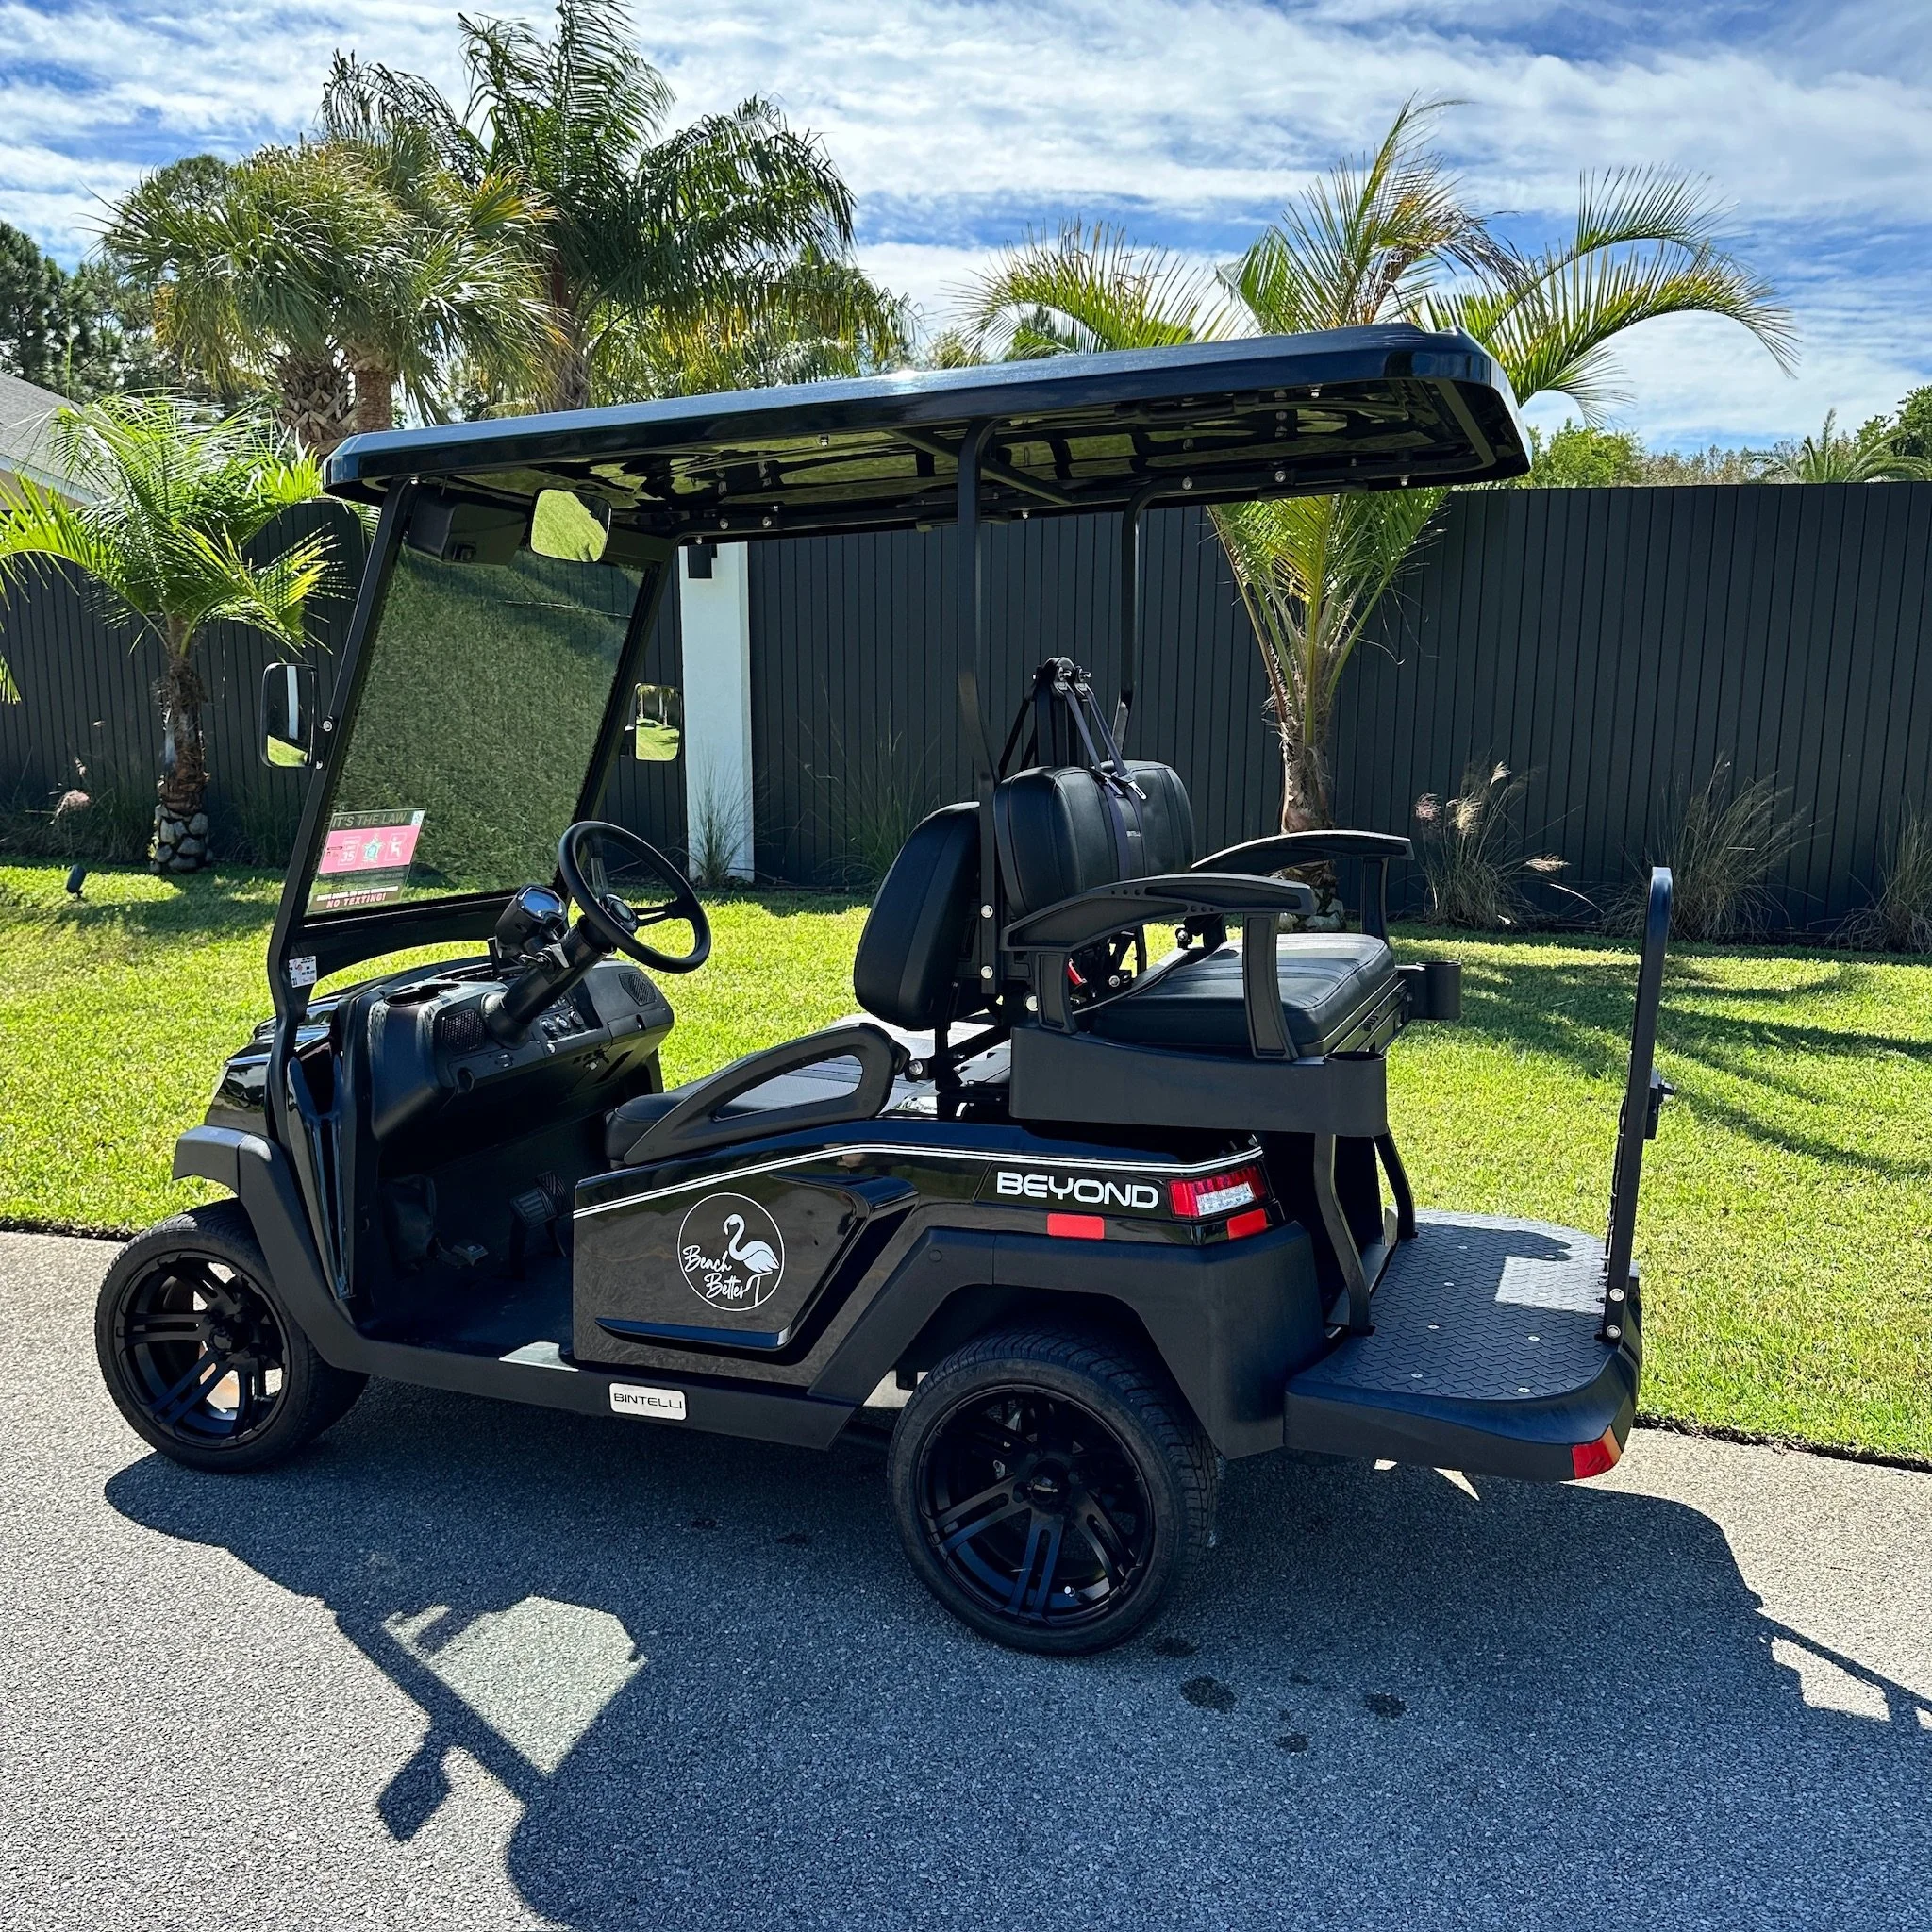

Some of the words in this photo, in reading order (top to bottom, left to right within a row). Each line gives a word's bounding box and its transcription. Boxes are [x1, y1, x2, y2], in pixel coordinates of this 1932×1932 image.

[332, 815, 355, 828] IT'S
[358, 814, 378, 825] THE
[381, 811, 408, 824] LAW
[341, 851, 356, 863] 35
[325, 899, 341, 908] NO
[343, 892, 387, 907] TEXTING!
[996, 1171, 1159, 1209] BEYOND
[682, 1244, 732, 1273] Beach
[703, 1272, 748, 1300] Better
[613, 1392, 683, 1409] BINTELLI
